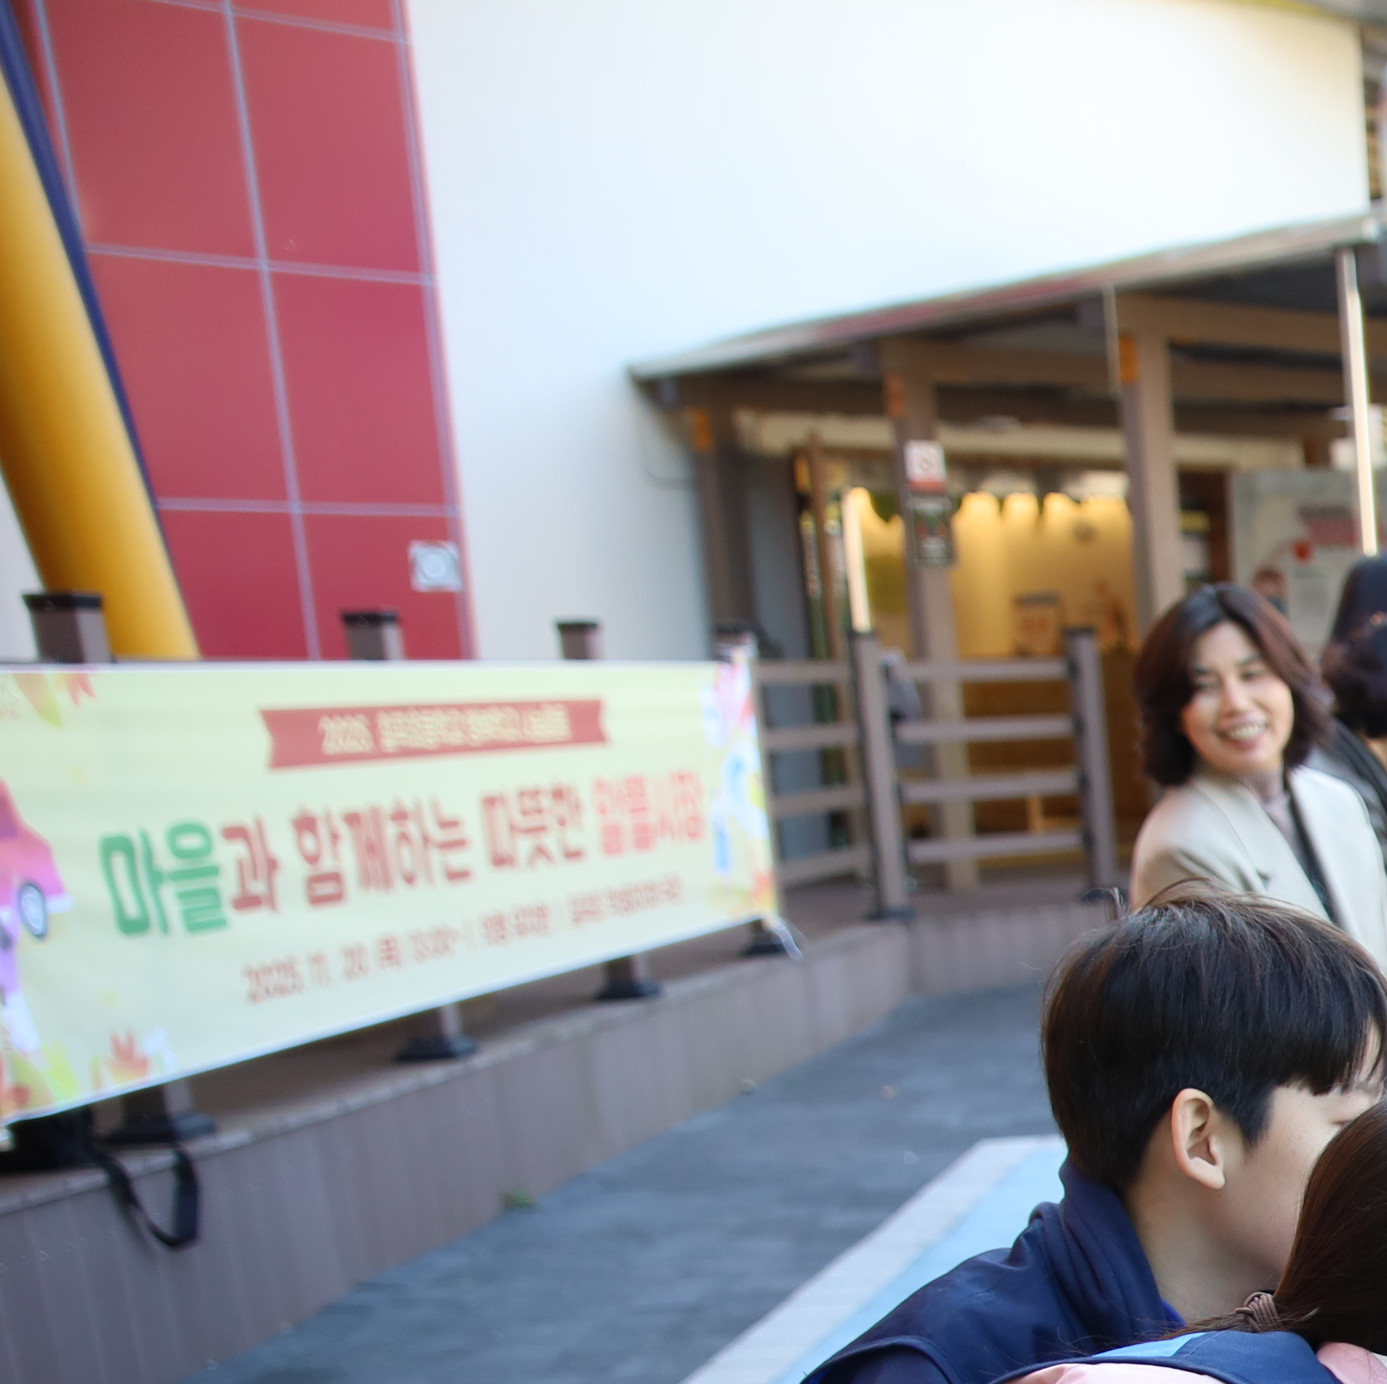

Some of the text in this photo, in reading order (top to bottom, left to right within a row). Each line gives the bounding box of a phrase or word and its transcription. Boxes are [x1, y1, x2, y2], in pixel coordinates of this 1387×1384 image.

[100, 816, 281, 938] 마을과
[292, 797, 474, 907] 함께하는
[481, 781, 586, 870] 따뜻한
[592, 771, 706, 859] 알뜰시장
